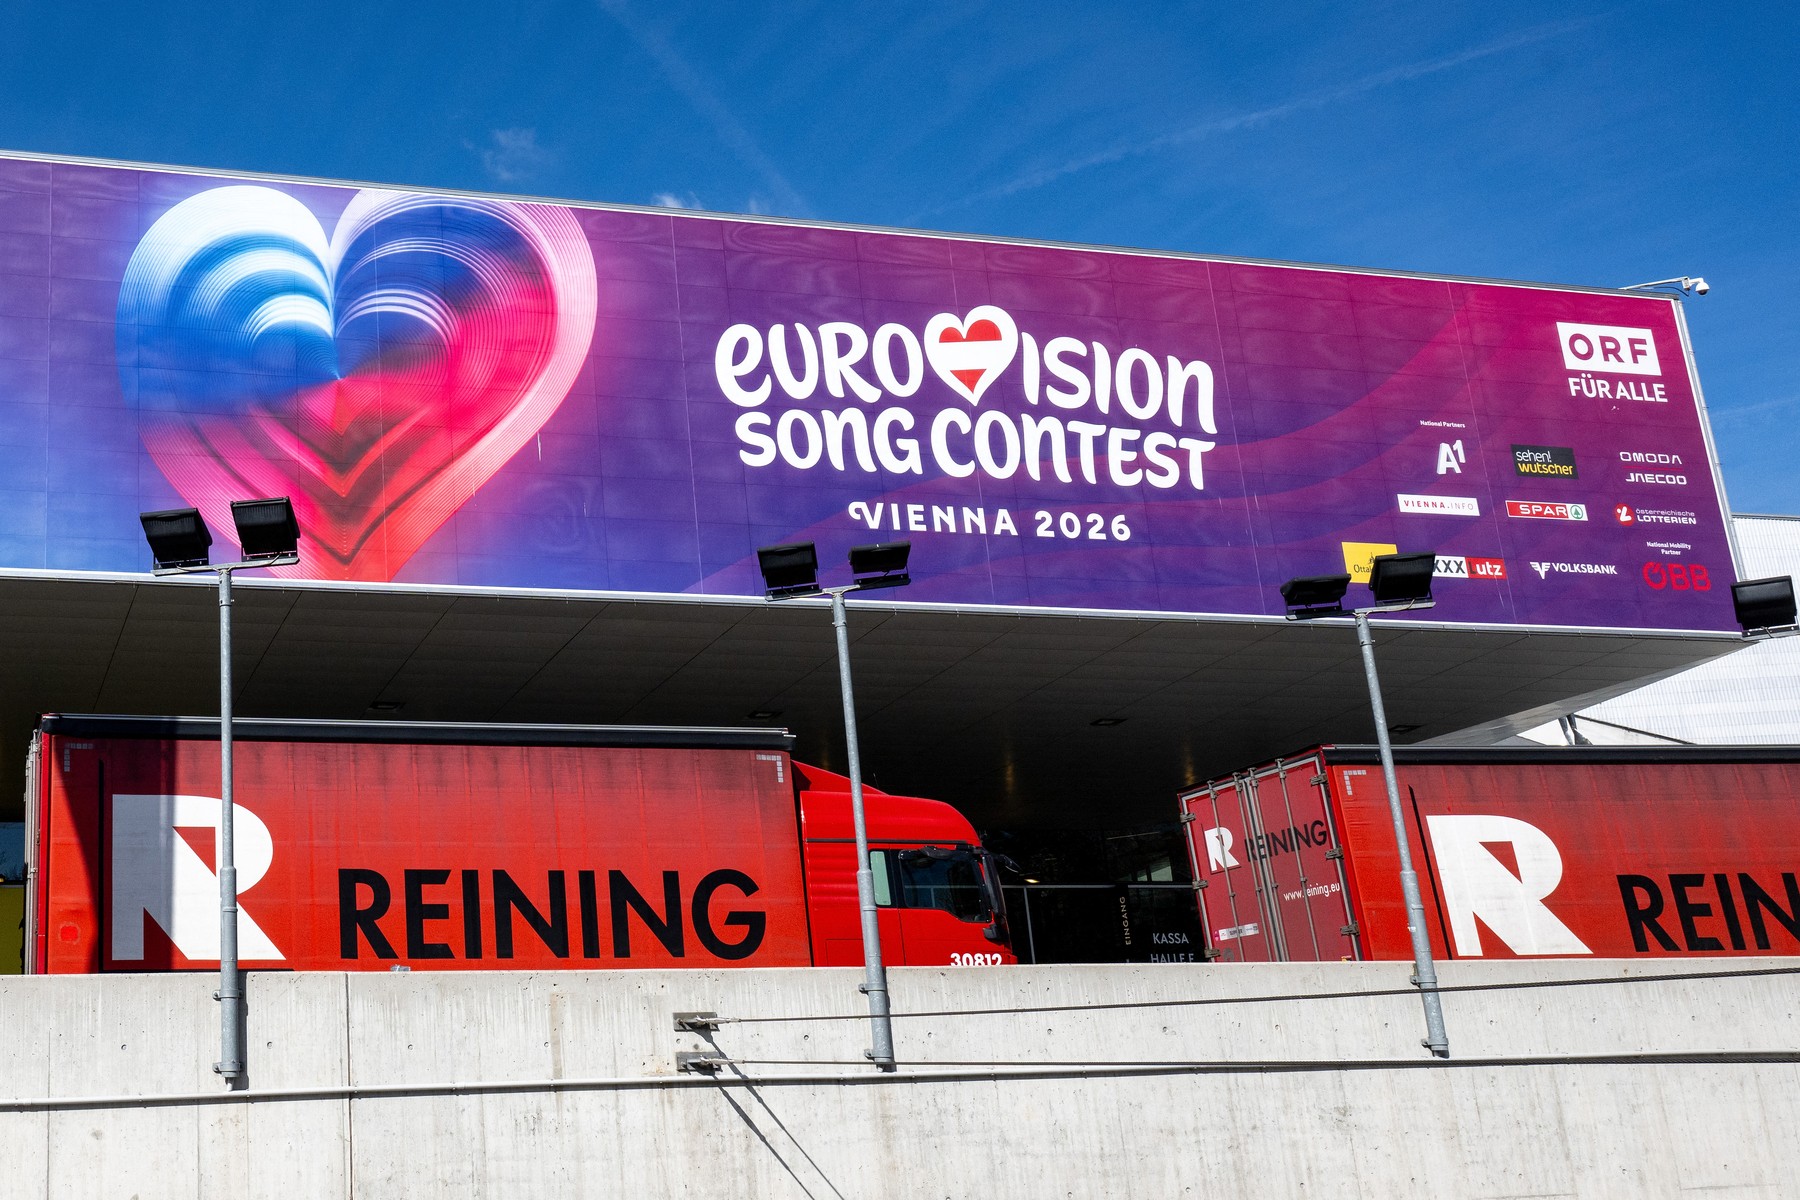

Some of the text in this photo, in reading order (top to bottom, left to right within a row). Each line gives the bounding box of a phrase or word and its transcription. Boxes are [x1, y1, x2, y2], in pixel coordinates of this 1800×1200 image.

[1568, 333, 1648, 364] ORF
[1568, 373, 1668, 402] FÜR ALLE
[1420, 420, 1466, 429] National Partners
[735, 407, 1216, 490] SONG CONTEST
[1436, 439, 1466, 475] A1
[1515, 449, 1552, 463] sehen!
[1619, 451, 1683, 464] OMODA
[1518, 462, 1574, 475] wutscher
[1625, 472, 1687, 485] JAECOO
[847, 502, 1131, 541] VIENNA 2026
[1519, 504, 1568, 517] SPAR
[1636, 515, 1697, 525] LOTTERIEN
[1646, 541, 1691, 550] National Mobility
[1660, 548, 1681, 556] Partner
[1552, 562, 1618, 575] VOLKSBANK
[1642, 561, 1711, 592] ÖBB
[1204, 827, 1240, 872] R
[1244, 820, 1328, 862] REINING
[111, 793, 287, 961] R
[1426, 814, 1594, 956] R
[1283, 882, 1341, 901] www.eining.eu
[338, 868, 767, 960] REINING
[1119, 896, 1132, 946] EINGANG
[1616, 872, 1800, 952] REIN
[1152, 932, 1190, 944] KASSA
[950, 952, 1002, 967] 30812
